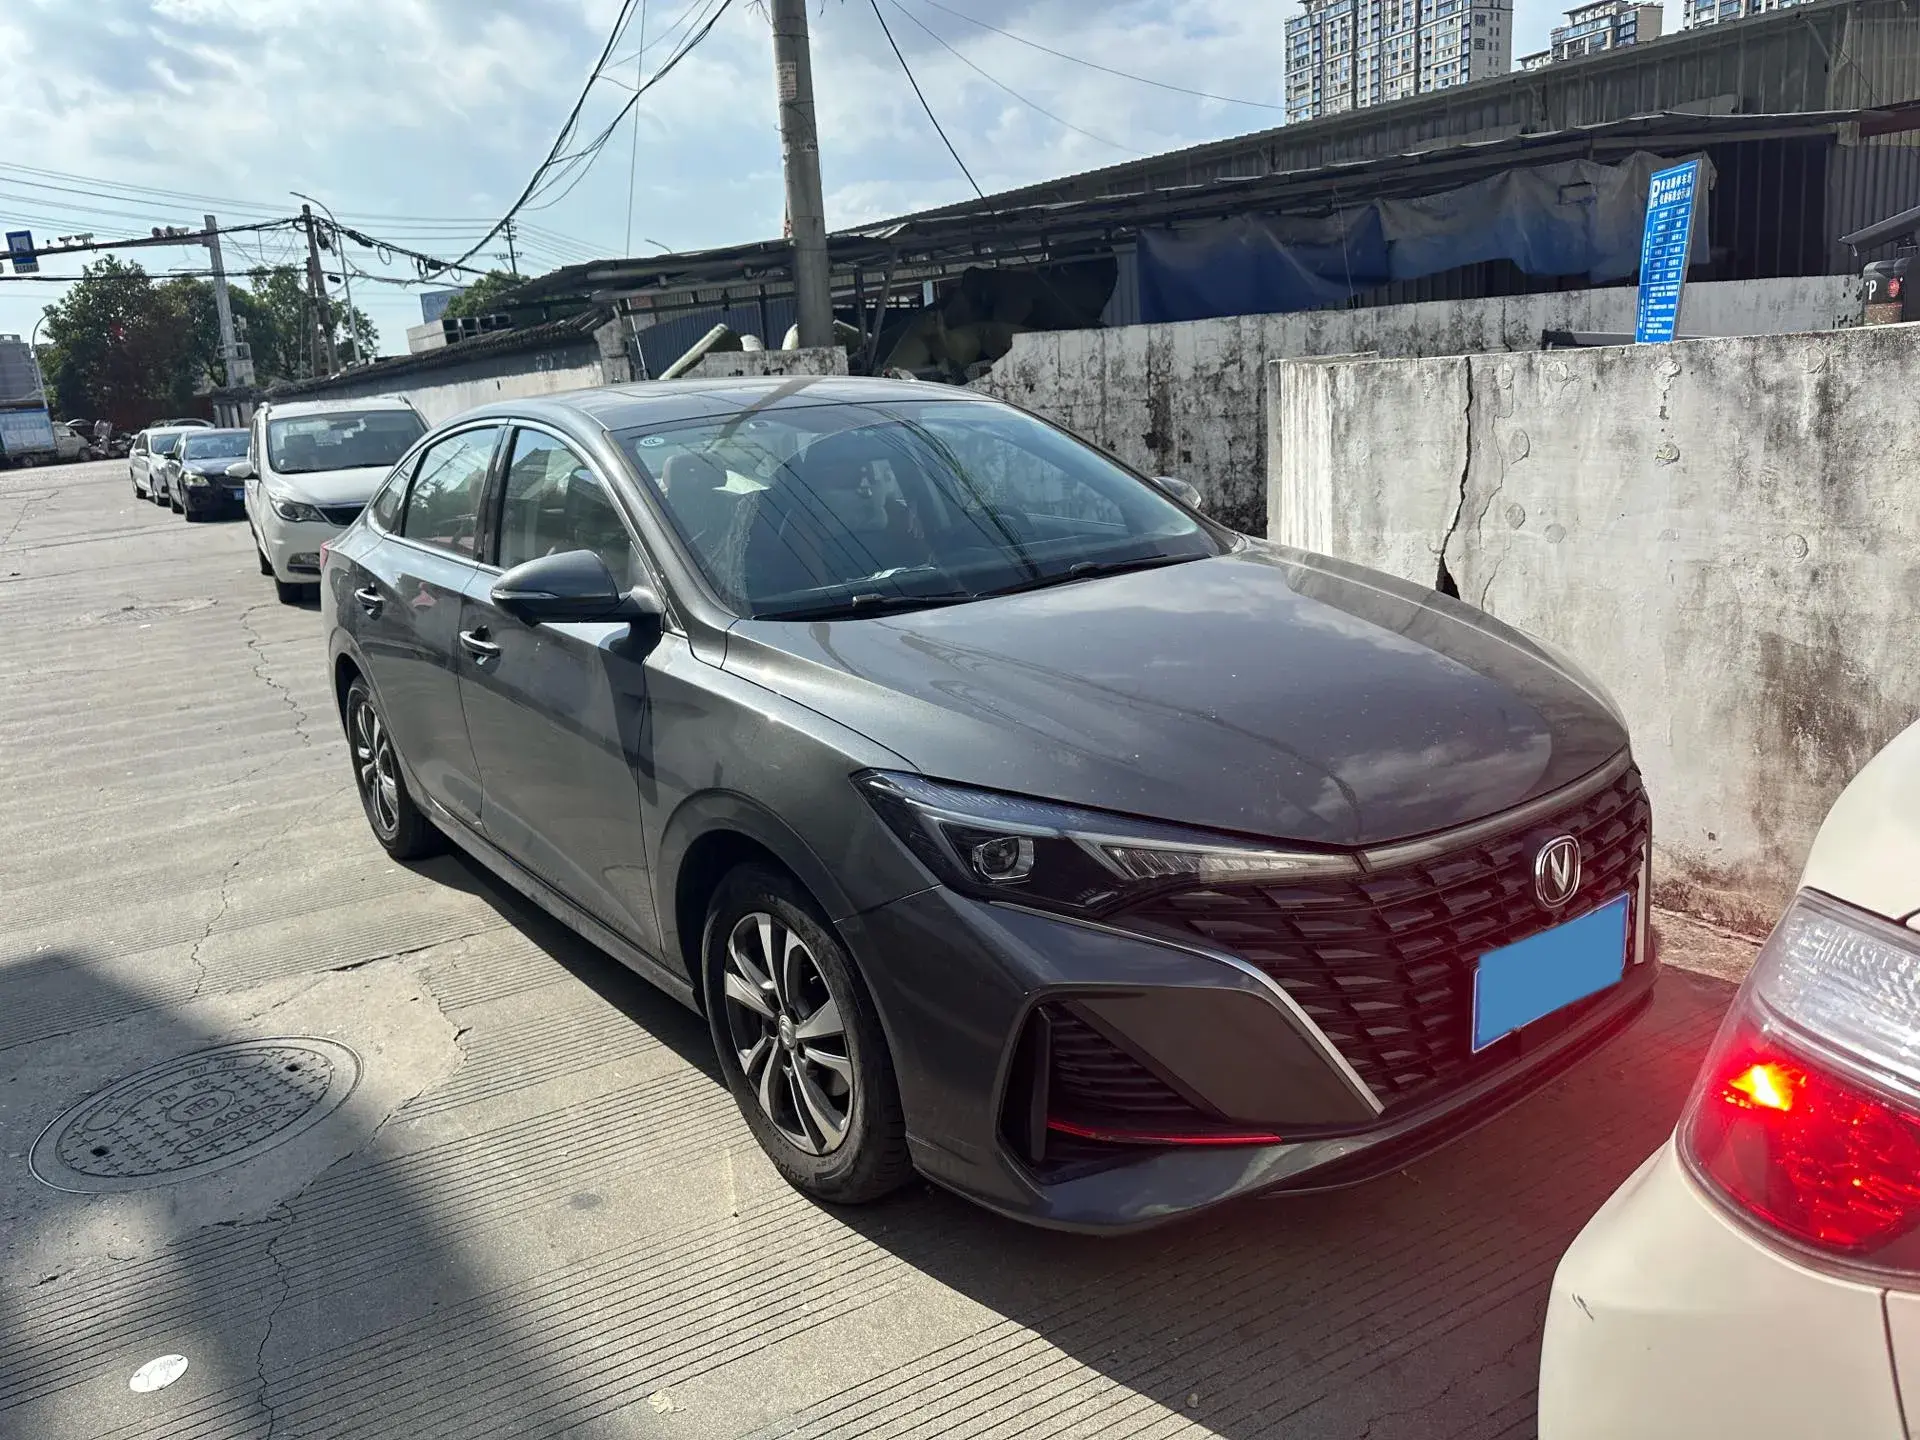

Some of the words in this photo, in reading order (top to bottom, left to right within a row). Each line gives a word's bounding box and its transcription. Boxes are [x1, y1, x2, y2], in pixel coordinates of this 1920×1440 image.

[1869, 280, 1877, 300] P
[186, 1128, 204, 1139] D
[212, 1104, 256, 1127] 400
